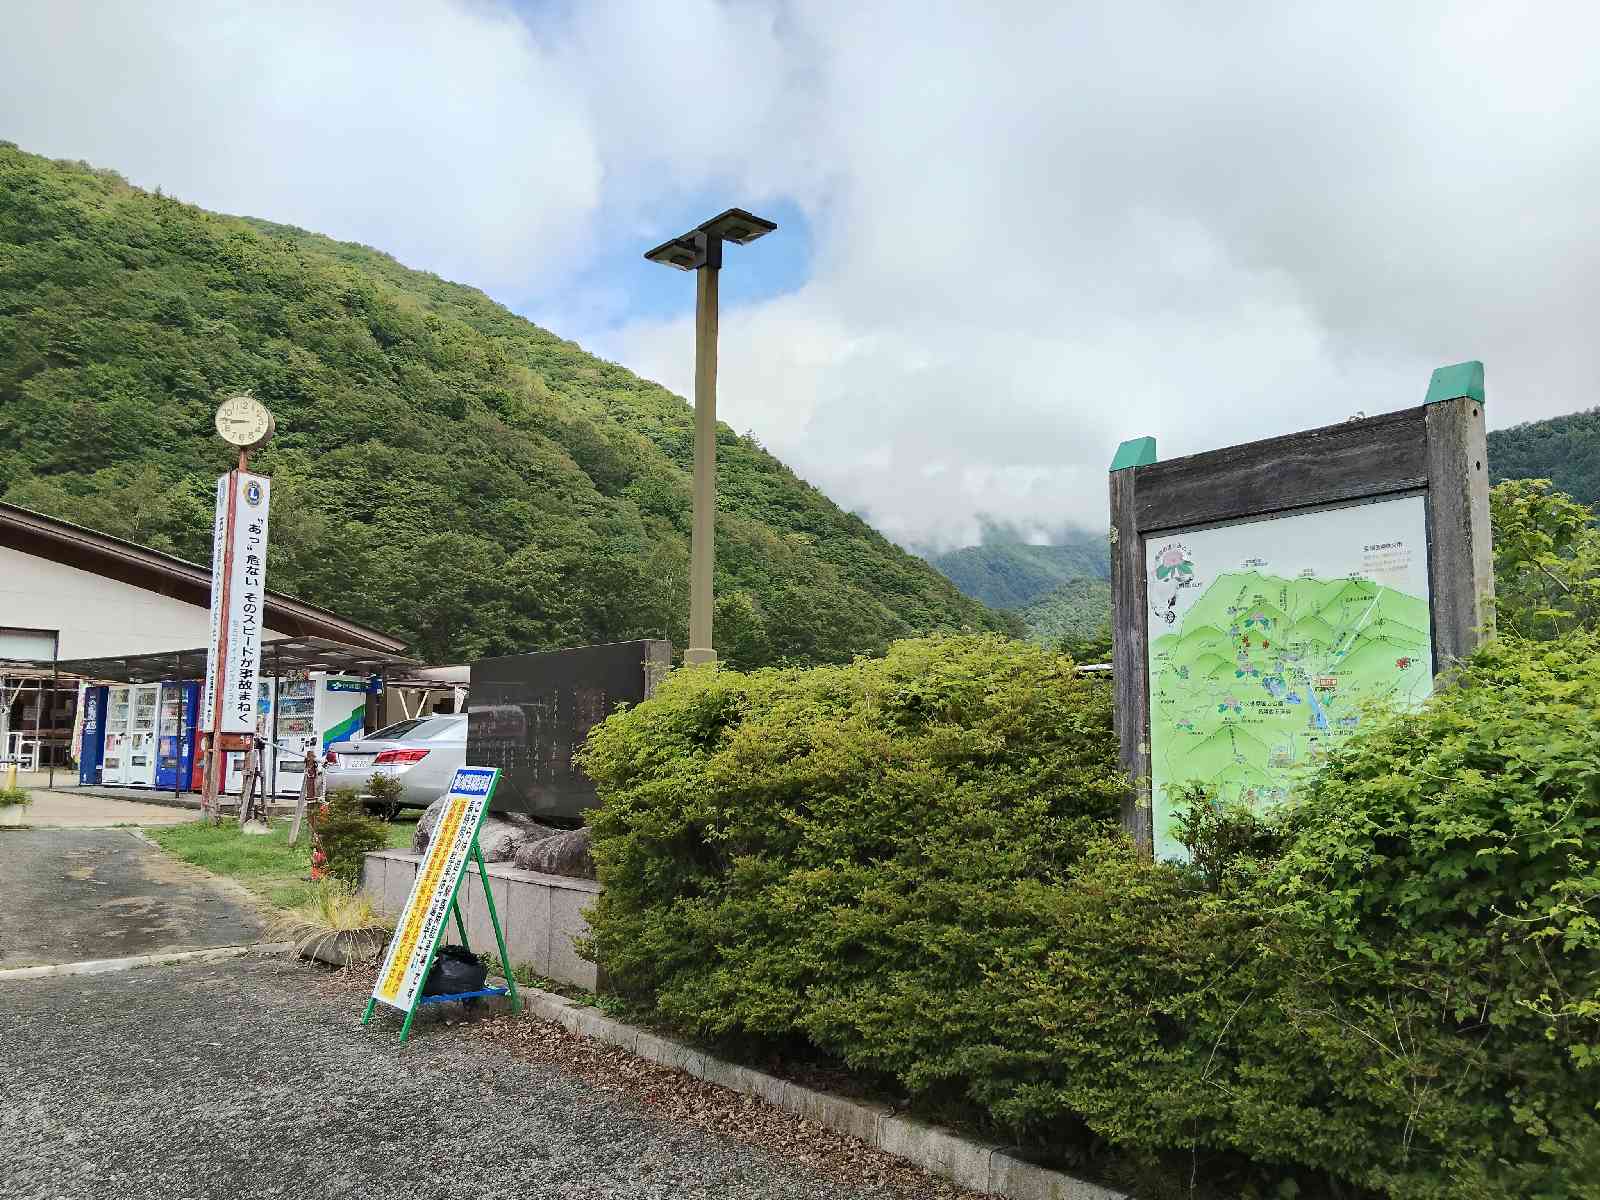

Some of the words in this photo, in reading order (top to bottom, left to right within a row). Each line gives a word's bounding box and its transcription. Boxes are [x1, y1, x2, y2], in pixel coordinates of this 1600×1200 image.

[237, 592, 258, 724] そのスピードが事故まねく
